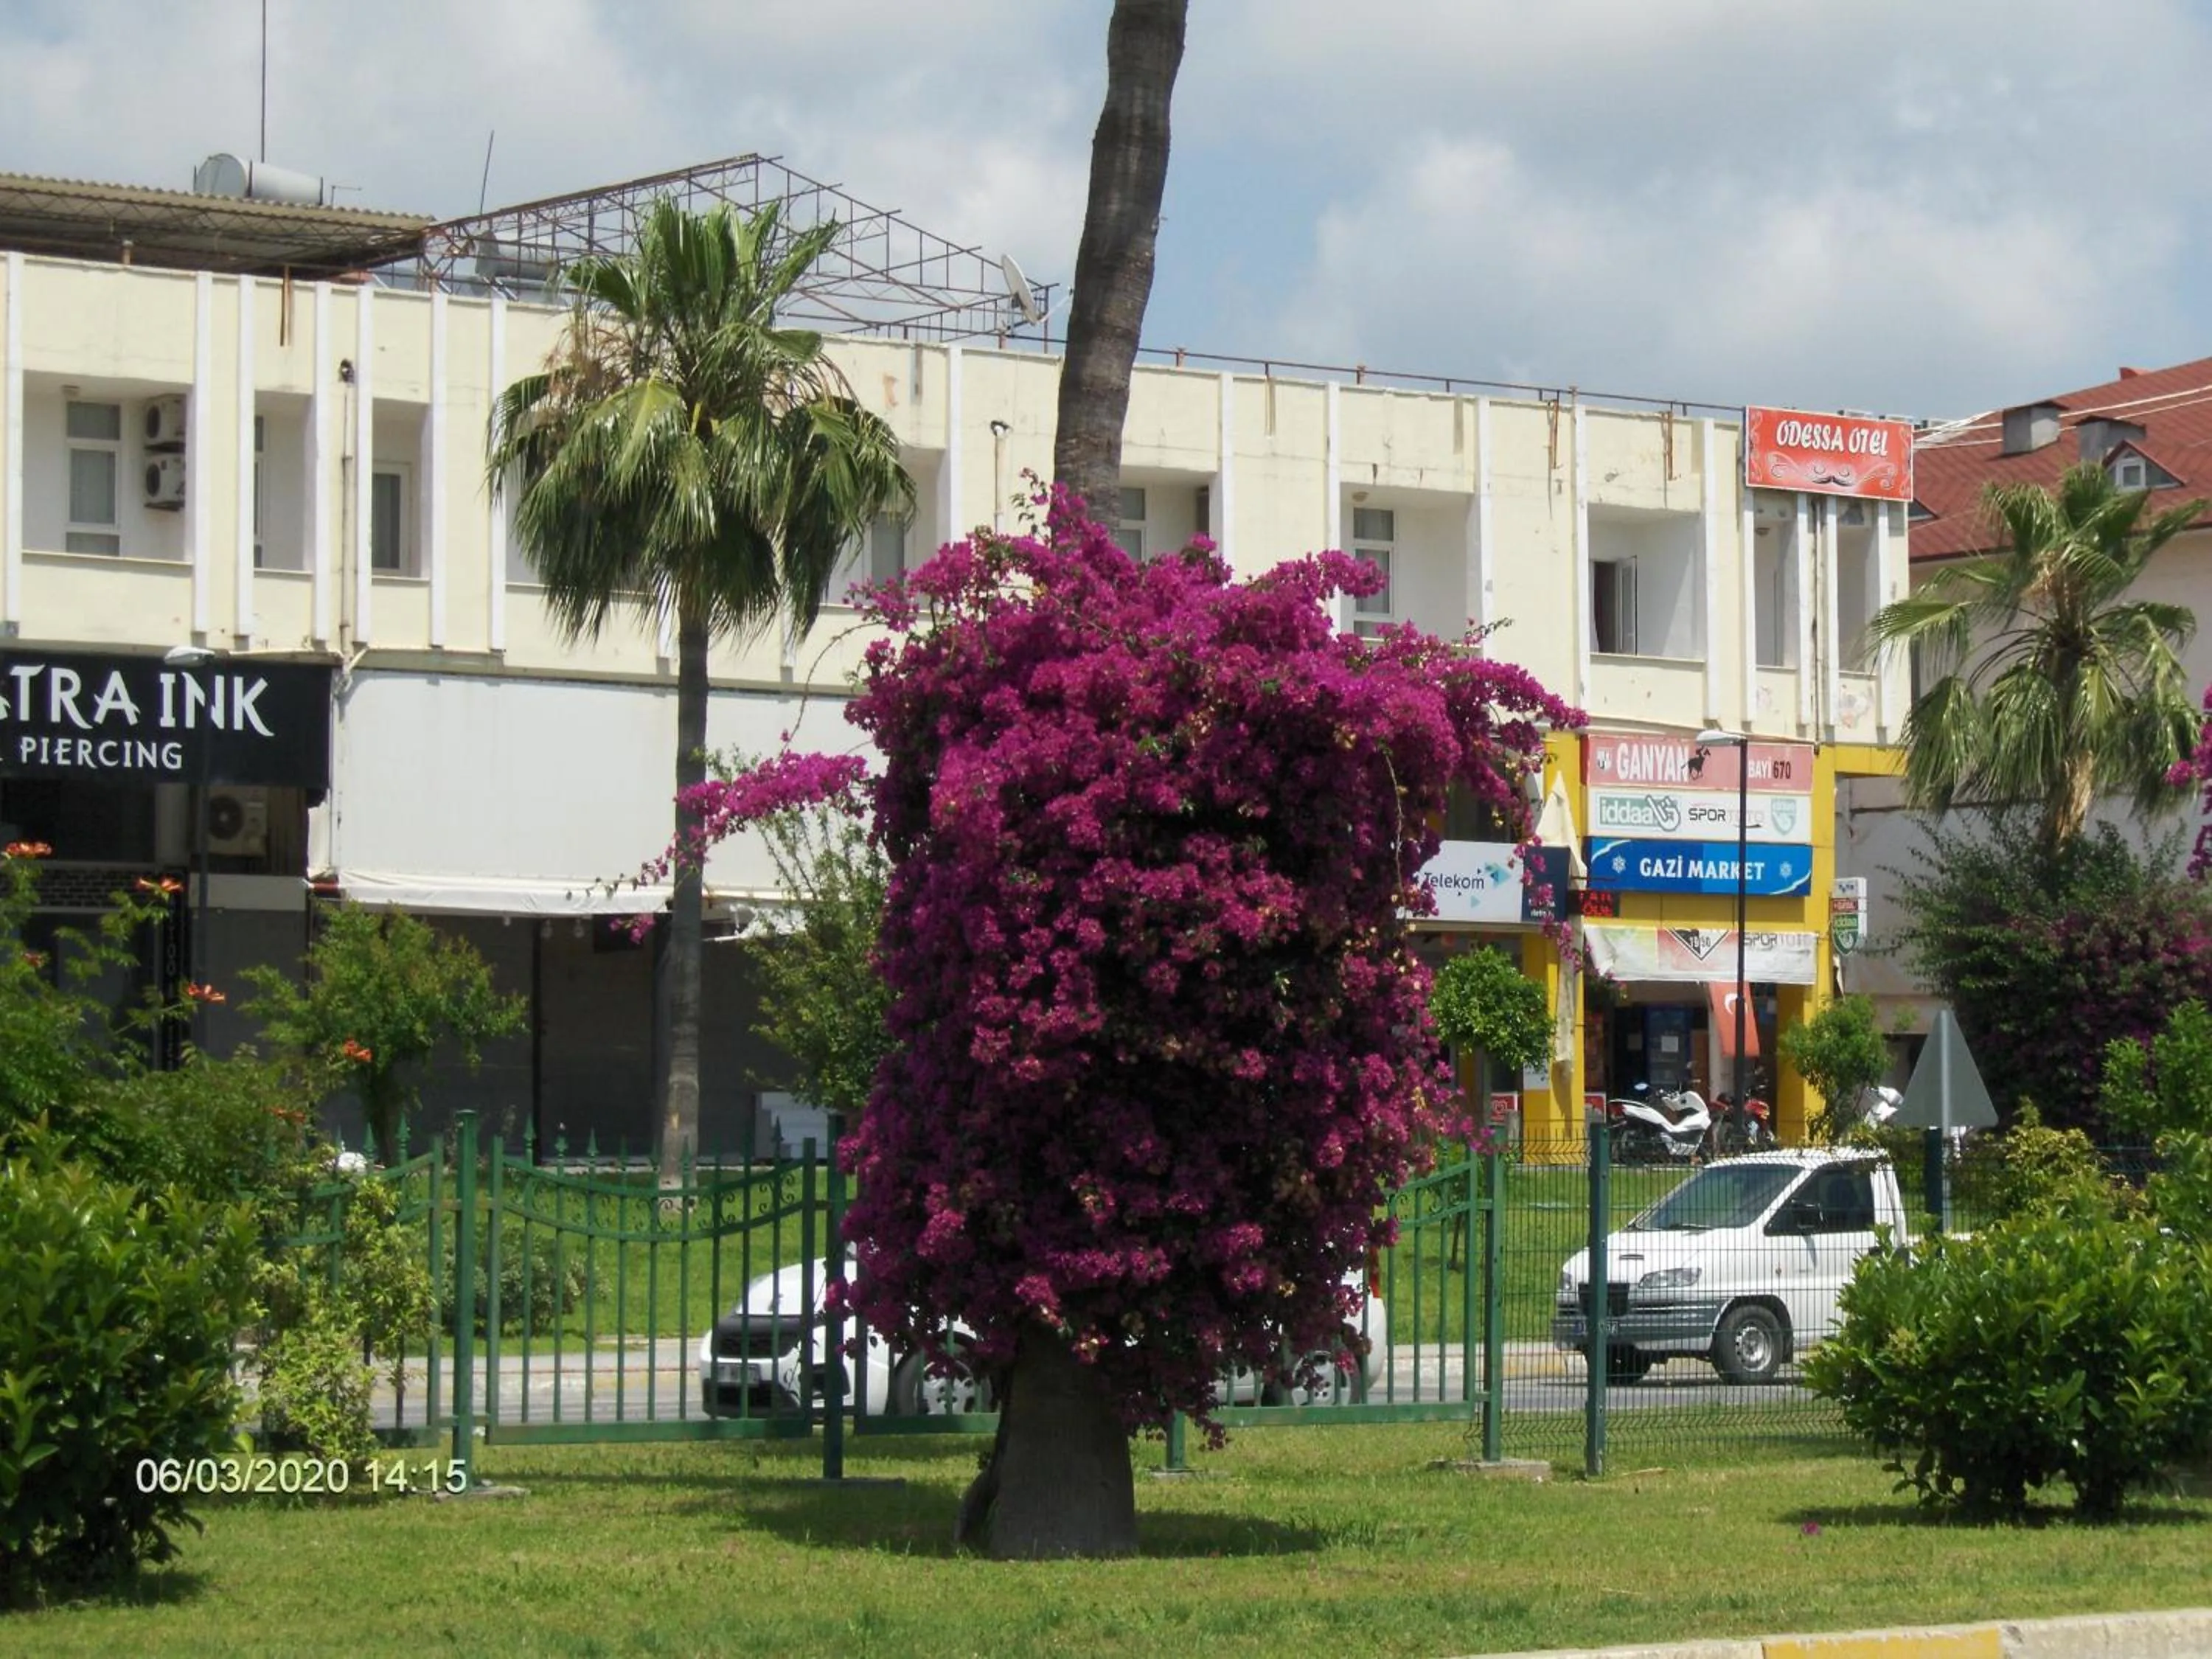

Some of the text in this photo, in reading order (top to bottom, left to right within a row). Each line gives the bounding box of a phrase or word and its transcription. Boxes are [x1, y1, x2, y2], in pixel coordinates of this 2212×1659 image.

[1775, 420, 1888, 456] ODESSA OTEL
[159, 671, 275, 737] INK
[20, 736, 183, 770] PIERCING
[1616, 742, 1689, 783] GANYAN
[1773, 760, 1792, 779] 670
[1601, 799, 1654, 824] iddaa
[1424, 872, 1485, 890] Telekom
[1639, 855, 1764, 880] GAZİ MARKET
